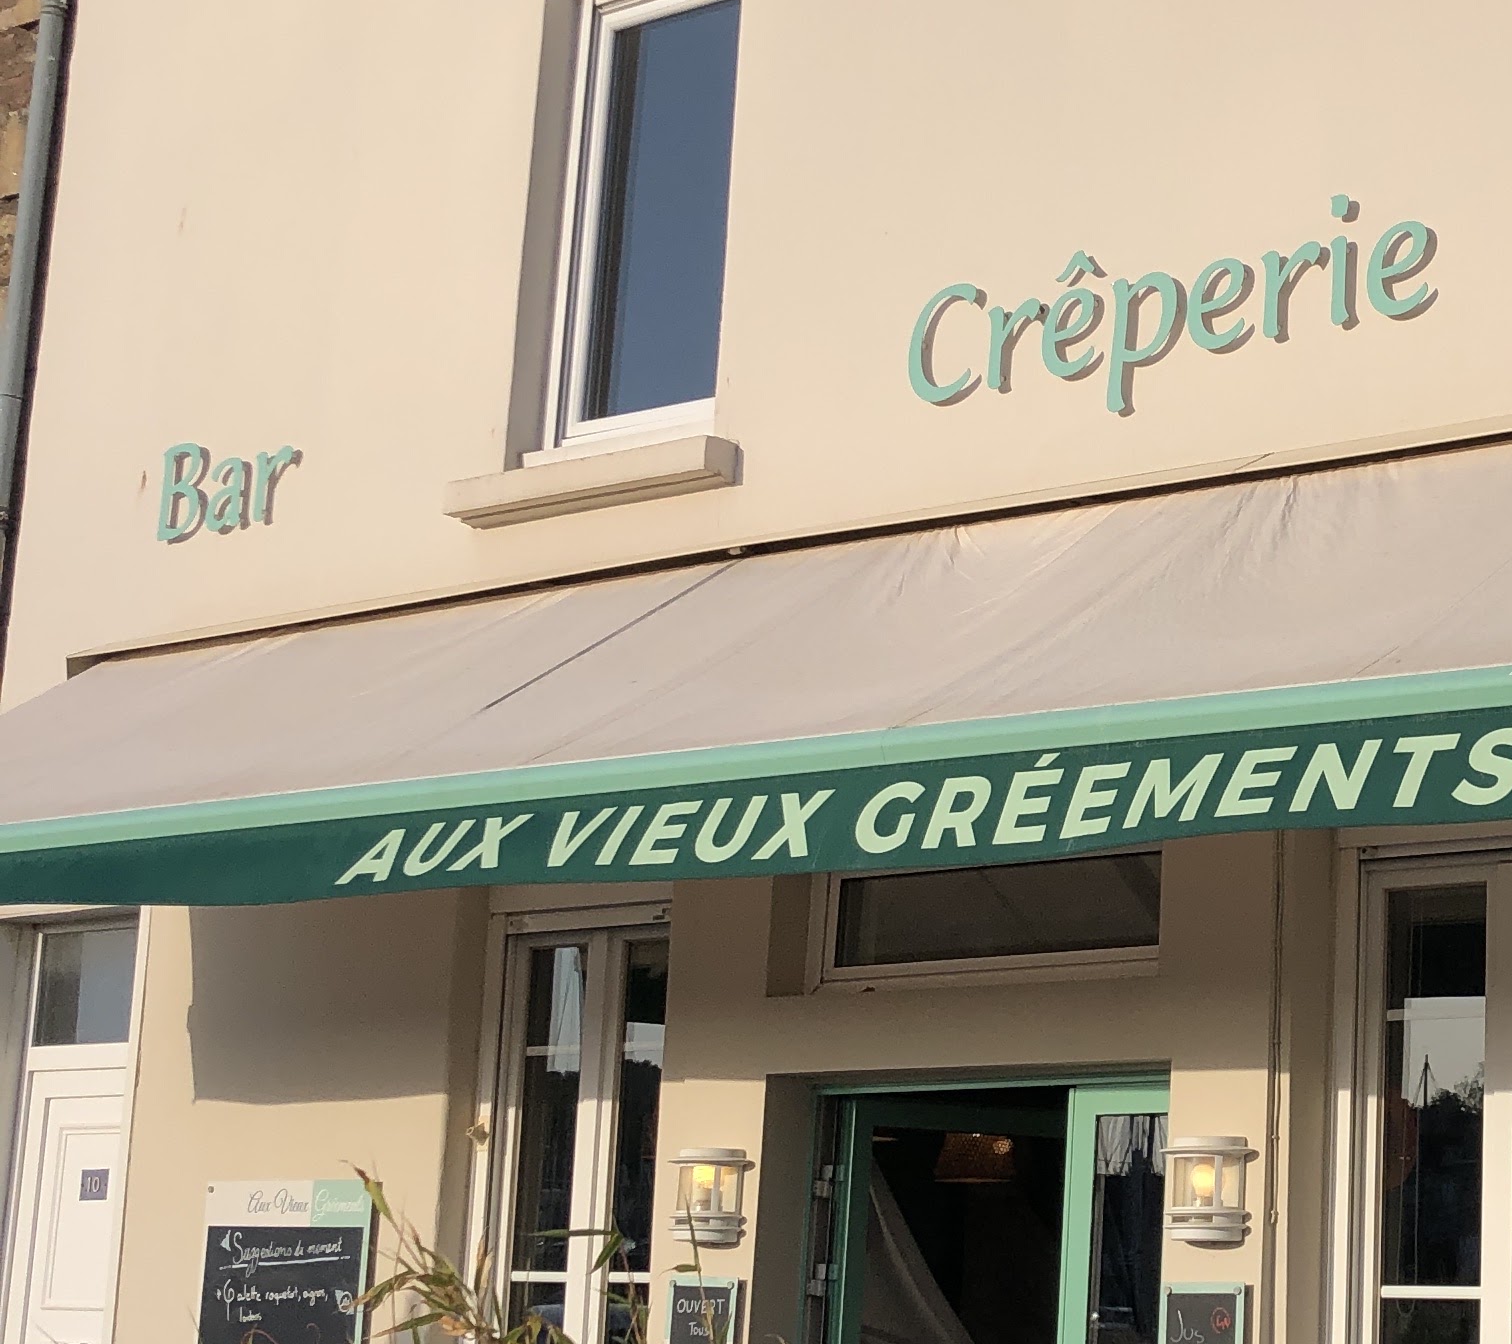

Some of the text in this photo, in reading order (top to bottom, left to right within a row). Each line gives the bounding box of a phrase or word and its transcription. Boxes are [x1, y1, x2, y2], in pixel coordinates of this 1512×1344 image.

[908, 194, 1432, 414] Crêperie
[157, 442, 297, 542] Bar
[336, 814, 537, 885] AUX
[545, 788, 836, 868] VIEUX
[87, 1176, 101, 1193] 10
[676, 1298, 726, 1315] OUVERT
[1169, 1309, 1205, 1344] Jus
